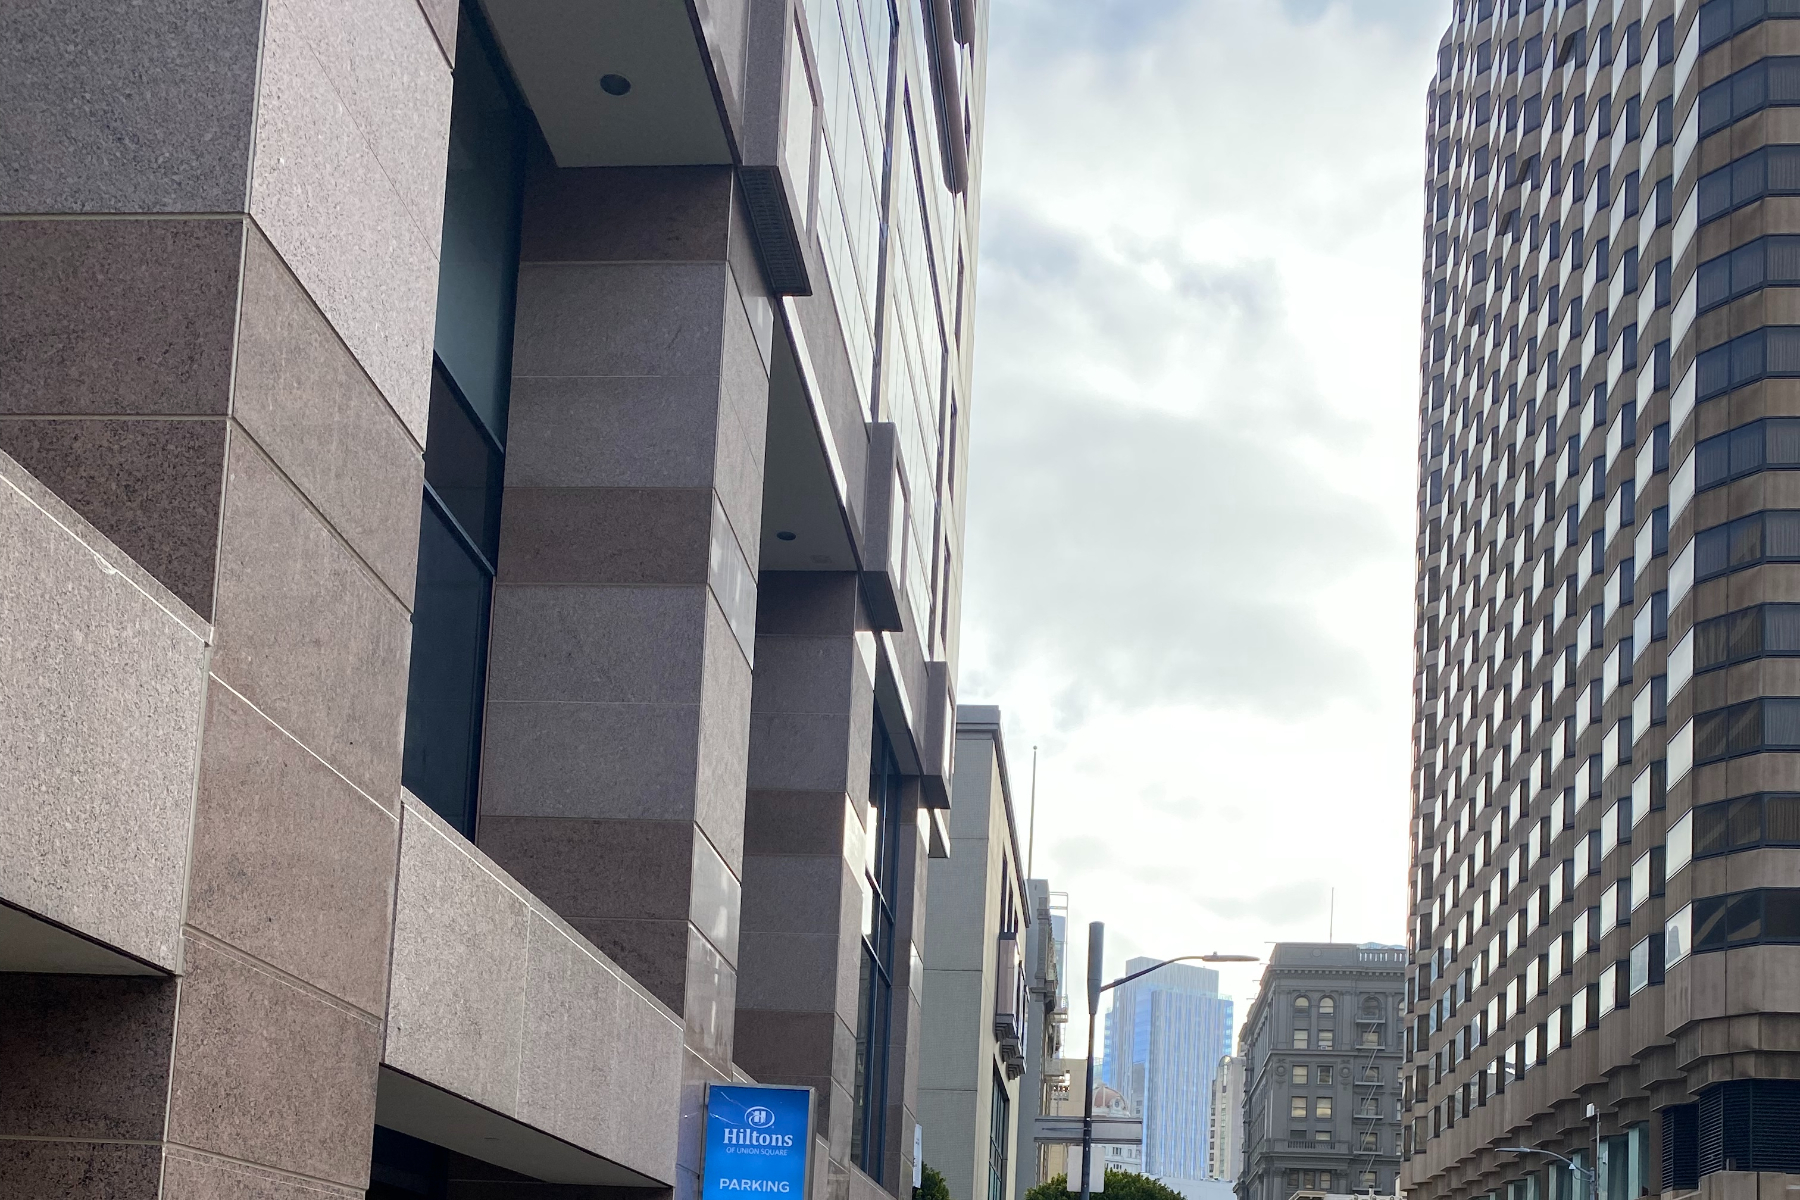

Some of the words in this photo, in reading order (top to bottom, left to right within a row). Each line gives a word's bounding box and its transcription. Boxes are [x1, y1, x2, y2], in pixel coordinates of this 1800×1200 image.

[723, 1128, 793, 1147] Hiltons
[736, 1147, 760, 1155] UNION
[760, 1148, 788, 1156] SQUARE
[719, 1178, 790, 1193] PARKING
